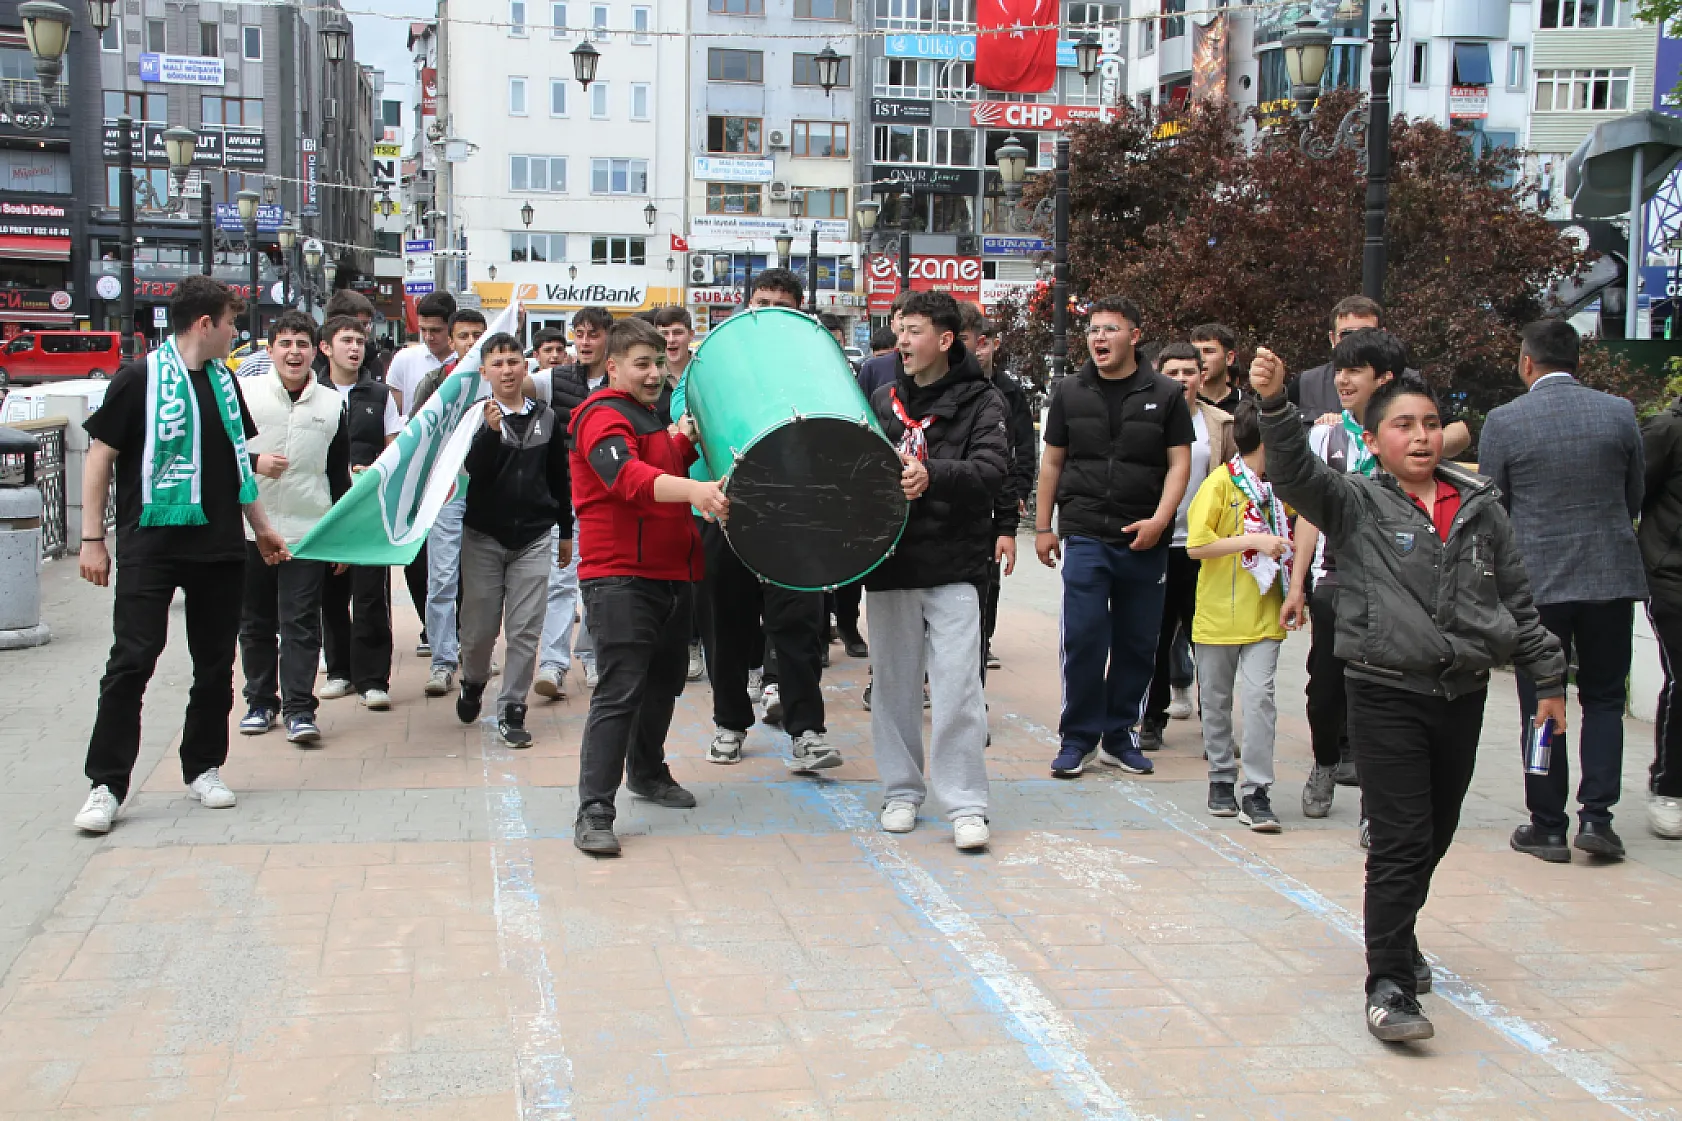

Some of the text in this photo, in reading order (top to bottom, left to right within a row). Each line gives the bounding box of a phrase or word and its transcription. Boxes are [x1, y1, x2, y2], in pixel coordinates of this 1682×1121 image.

[915, 35, 953, 57] Ülkü
[1005, 104, 1052, 127] CHP
[133, 277, 177, 298] Craz
[545, 283, 641, 303] VakıfBank
